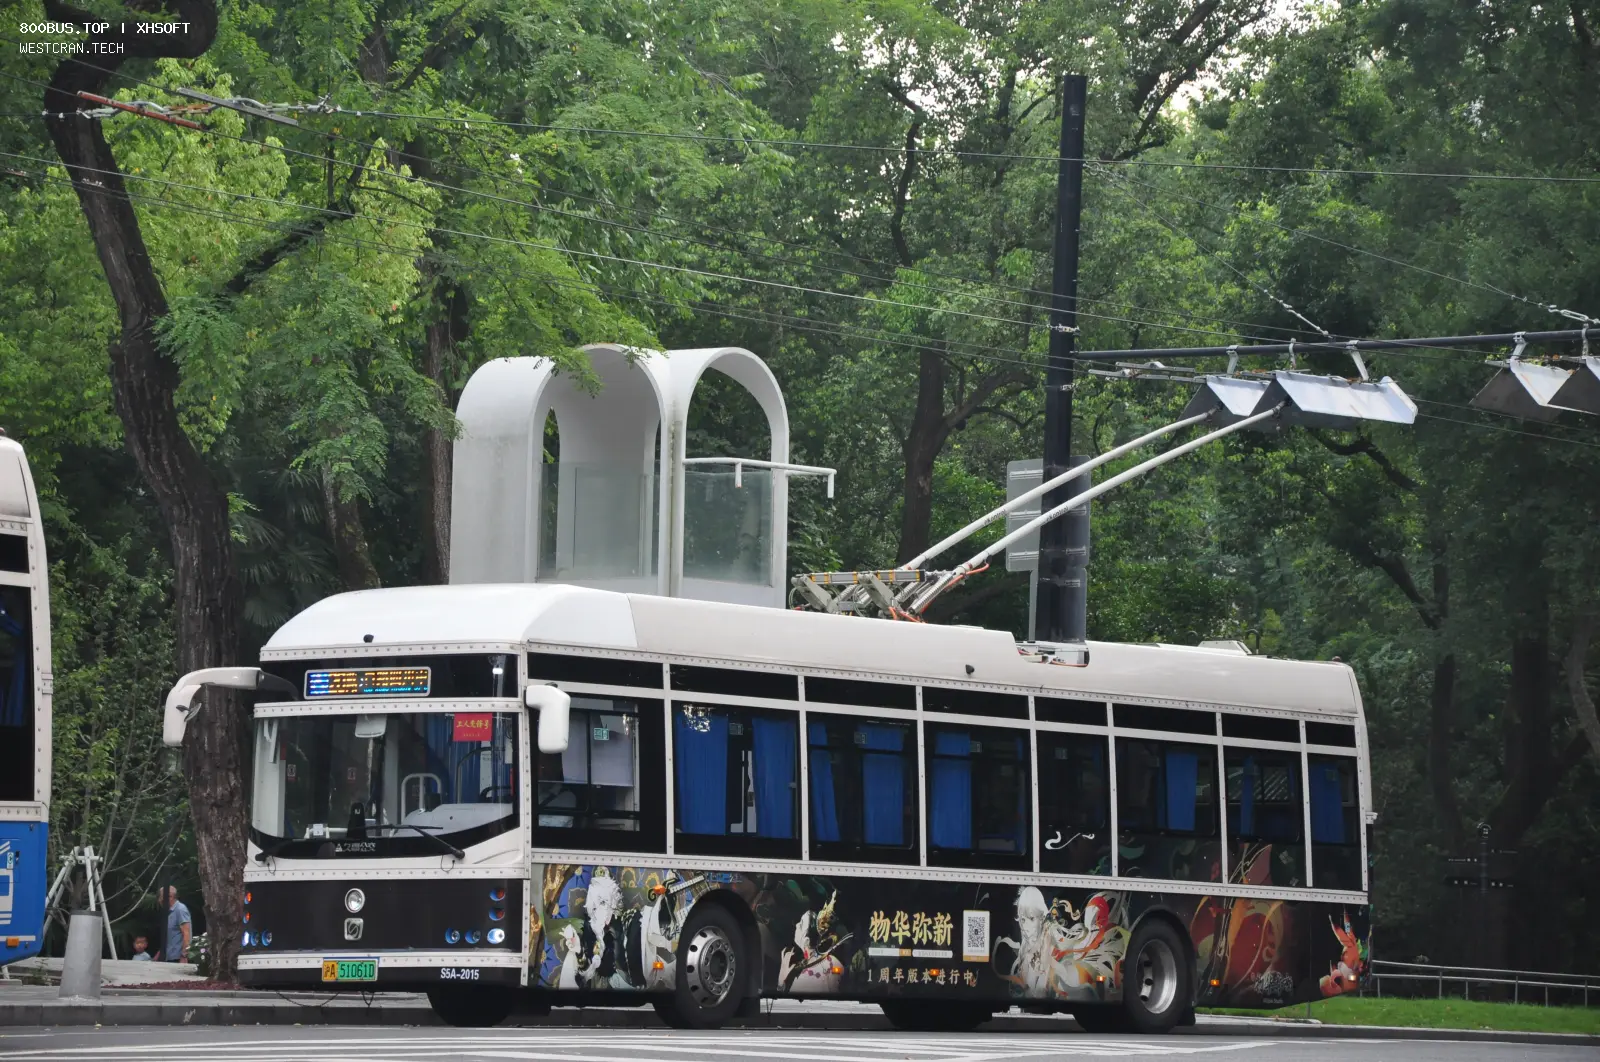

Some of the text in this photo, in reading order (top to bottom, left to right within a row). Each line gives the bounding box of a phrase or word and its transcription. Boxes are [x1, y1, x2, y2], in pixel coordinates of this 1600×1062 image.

[868, 910, 954, 946] 物华弥新
[440, 967, 480, 981] S5A-2015
